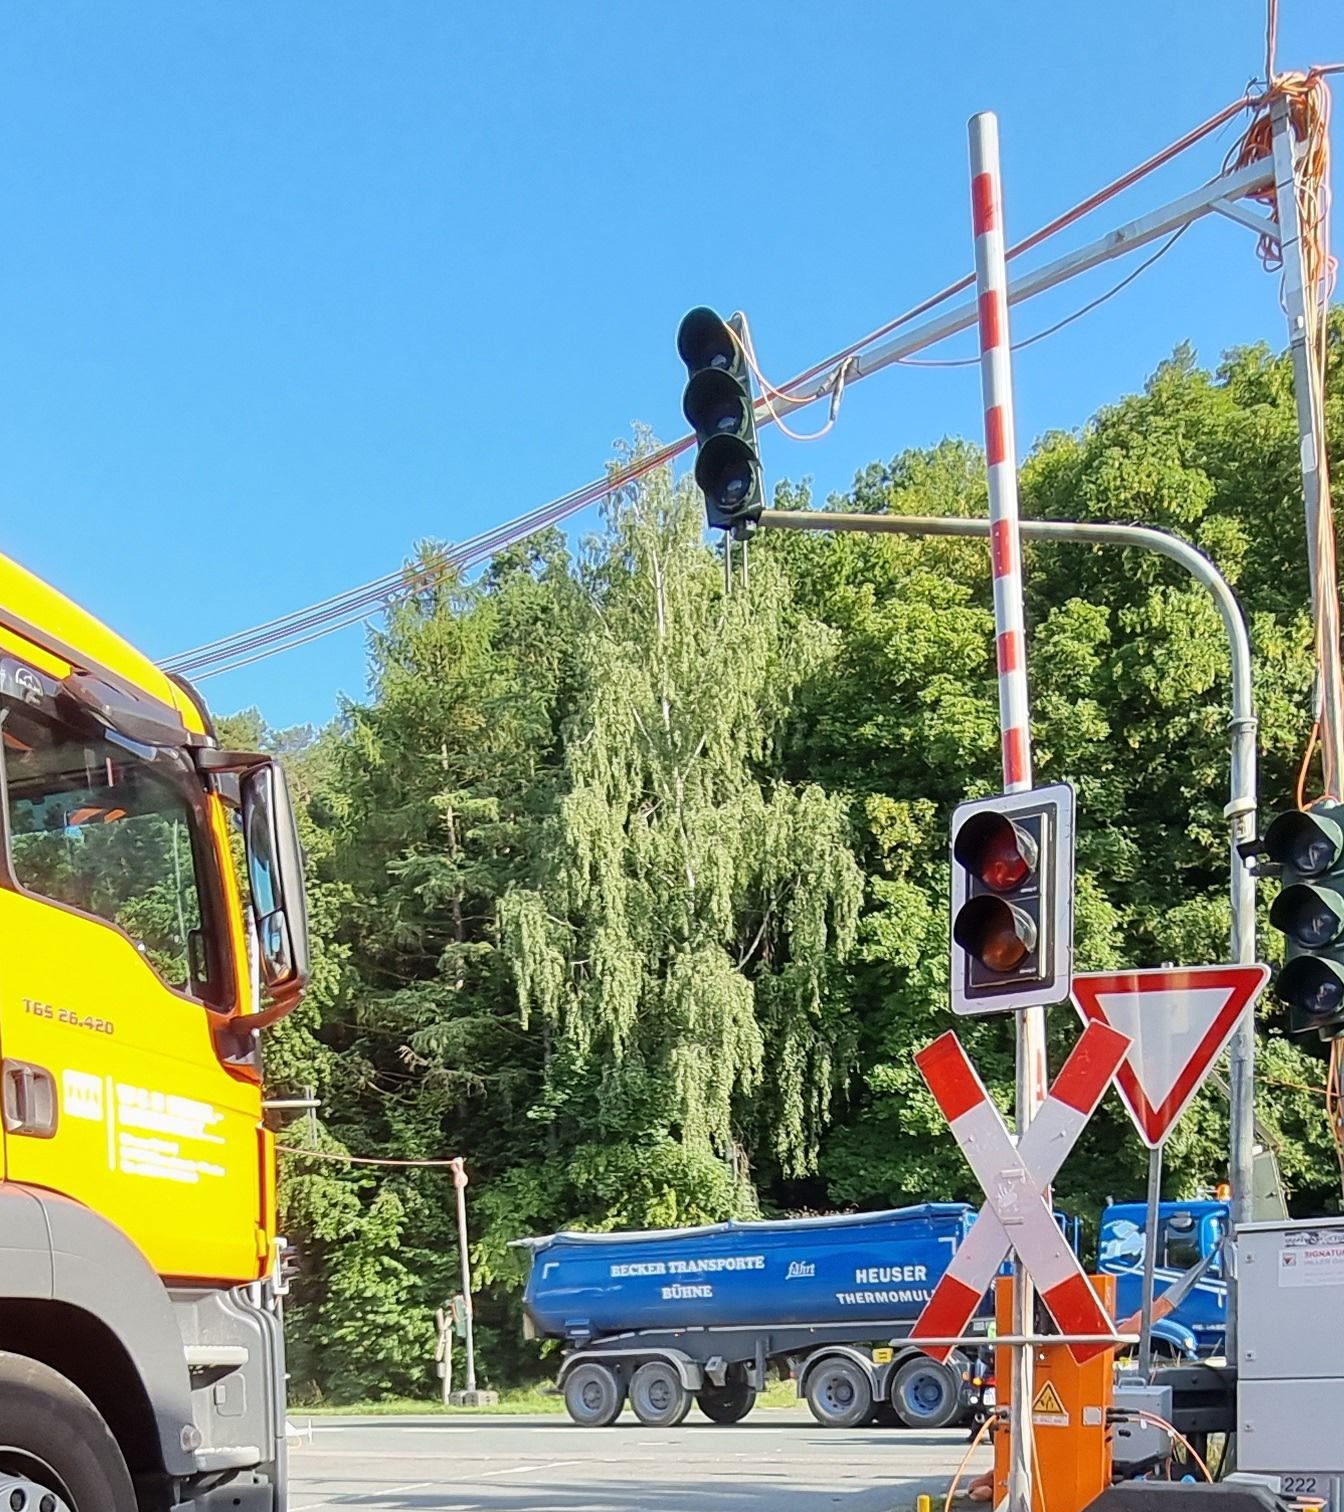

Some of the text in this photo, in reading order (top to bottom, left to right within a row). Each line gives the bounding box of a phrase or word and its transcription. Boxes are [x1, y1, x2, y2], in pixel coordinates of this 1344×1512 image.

[58, 1008, 115, 1035] 26.420
[610, 1256, 765, 1277] BECKER TRANSPORTE
[856, 1265, 927, 1284] HEUSER
[661, 1283, 713, 1300] BÜHNE
[836, 1289, 935, 1305] THERMOMUL
[1284, 1477, 1316, 1492] 222
